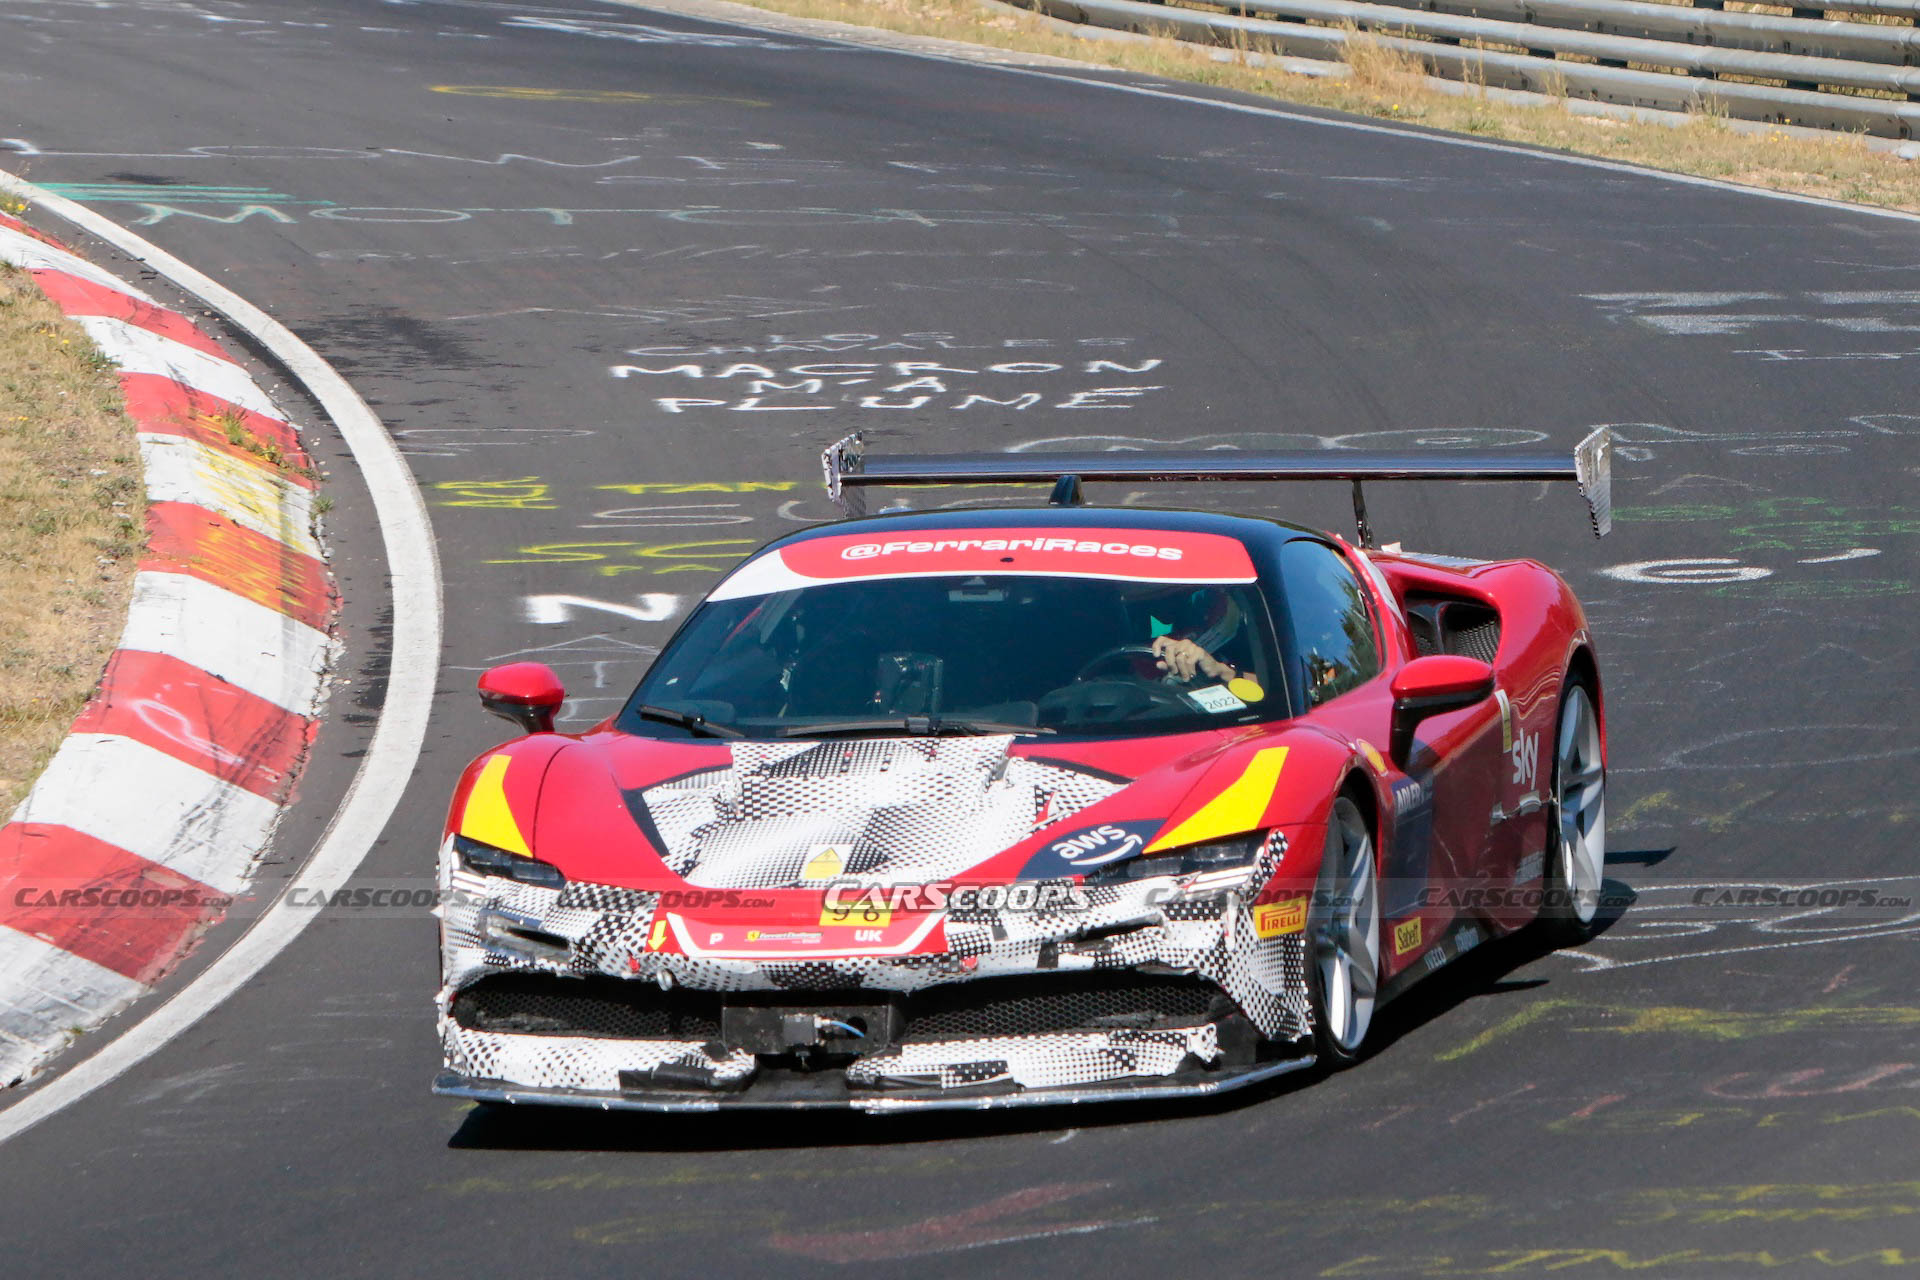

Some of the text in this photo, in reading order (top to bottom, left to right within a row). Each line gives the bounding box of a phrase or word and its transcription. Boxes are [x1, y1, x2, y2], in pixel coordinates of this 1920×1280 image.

[608, 359, 1163, 378] MACRON
[841, 537, 1184, 561] @FerrariRaces
[1205, 696, 1239, 710] 2022
[1511, 727, 1540, 791] sky
[1051, 825, 1127, 860] aws
[1261, 905, 1302, 932] PIRELLI
[854, 929, 883, 942] UK
